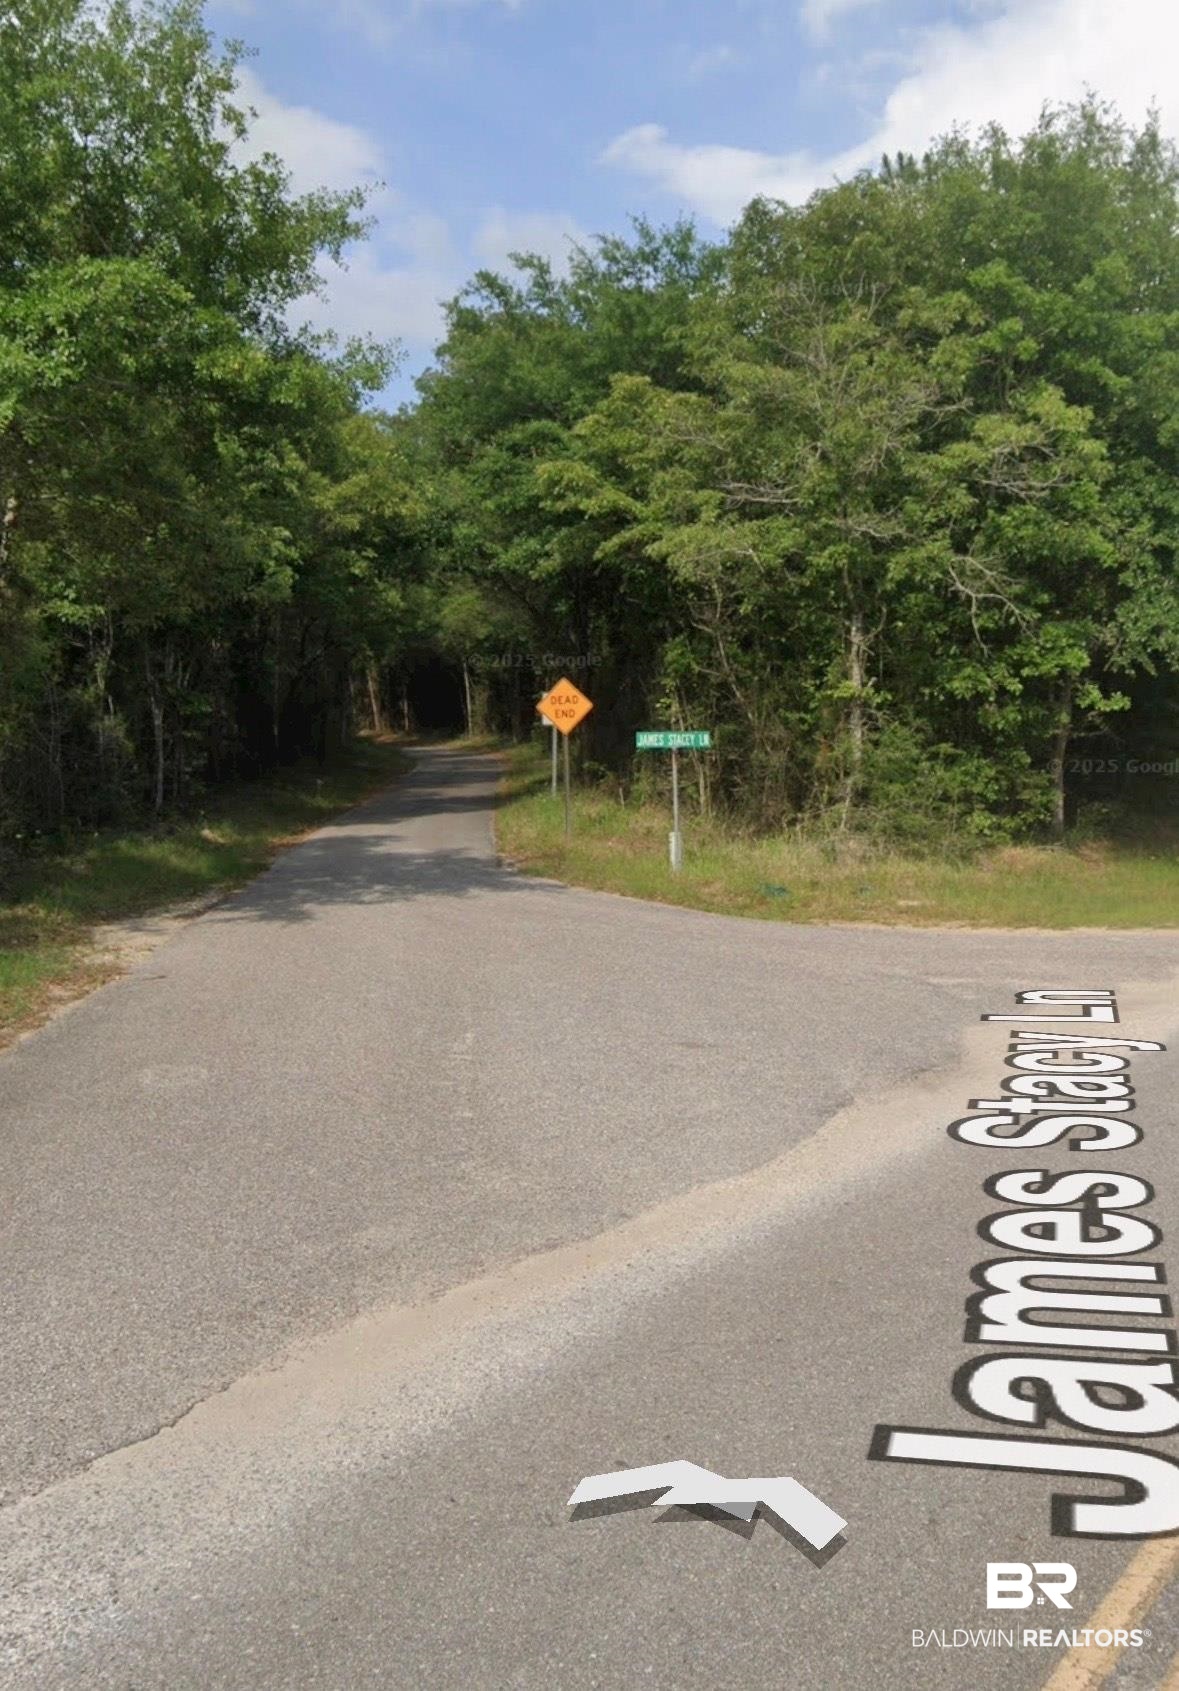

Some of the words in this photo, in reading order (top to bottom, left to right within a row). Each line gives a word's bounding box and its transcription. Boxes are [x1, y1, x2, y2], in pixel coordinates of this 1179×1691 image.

[550, 695, 578, 706] DEAD
[554, 708, 576, 719] END
[637, 733, 664, 747] JAMES
